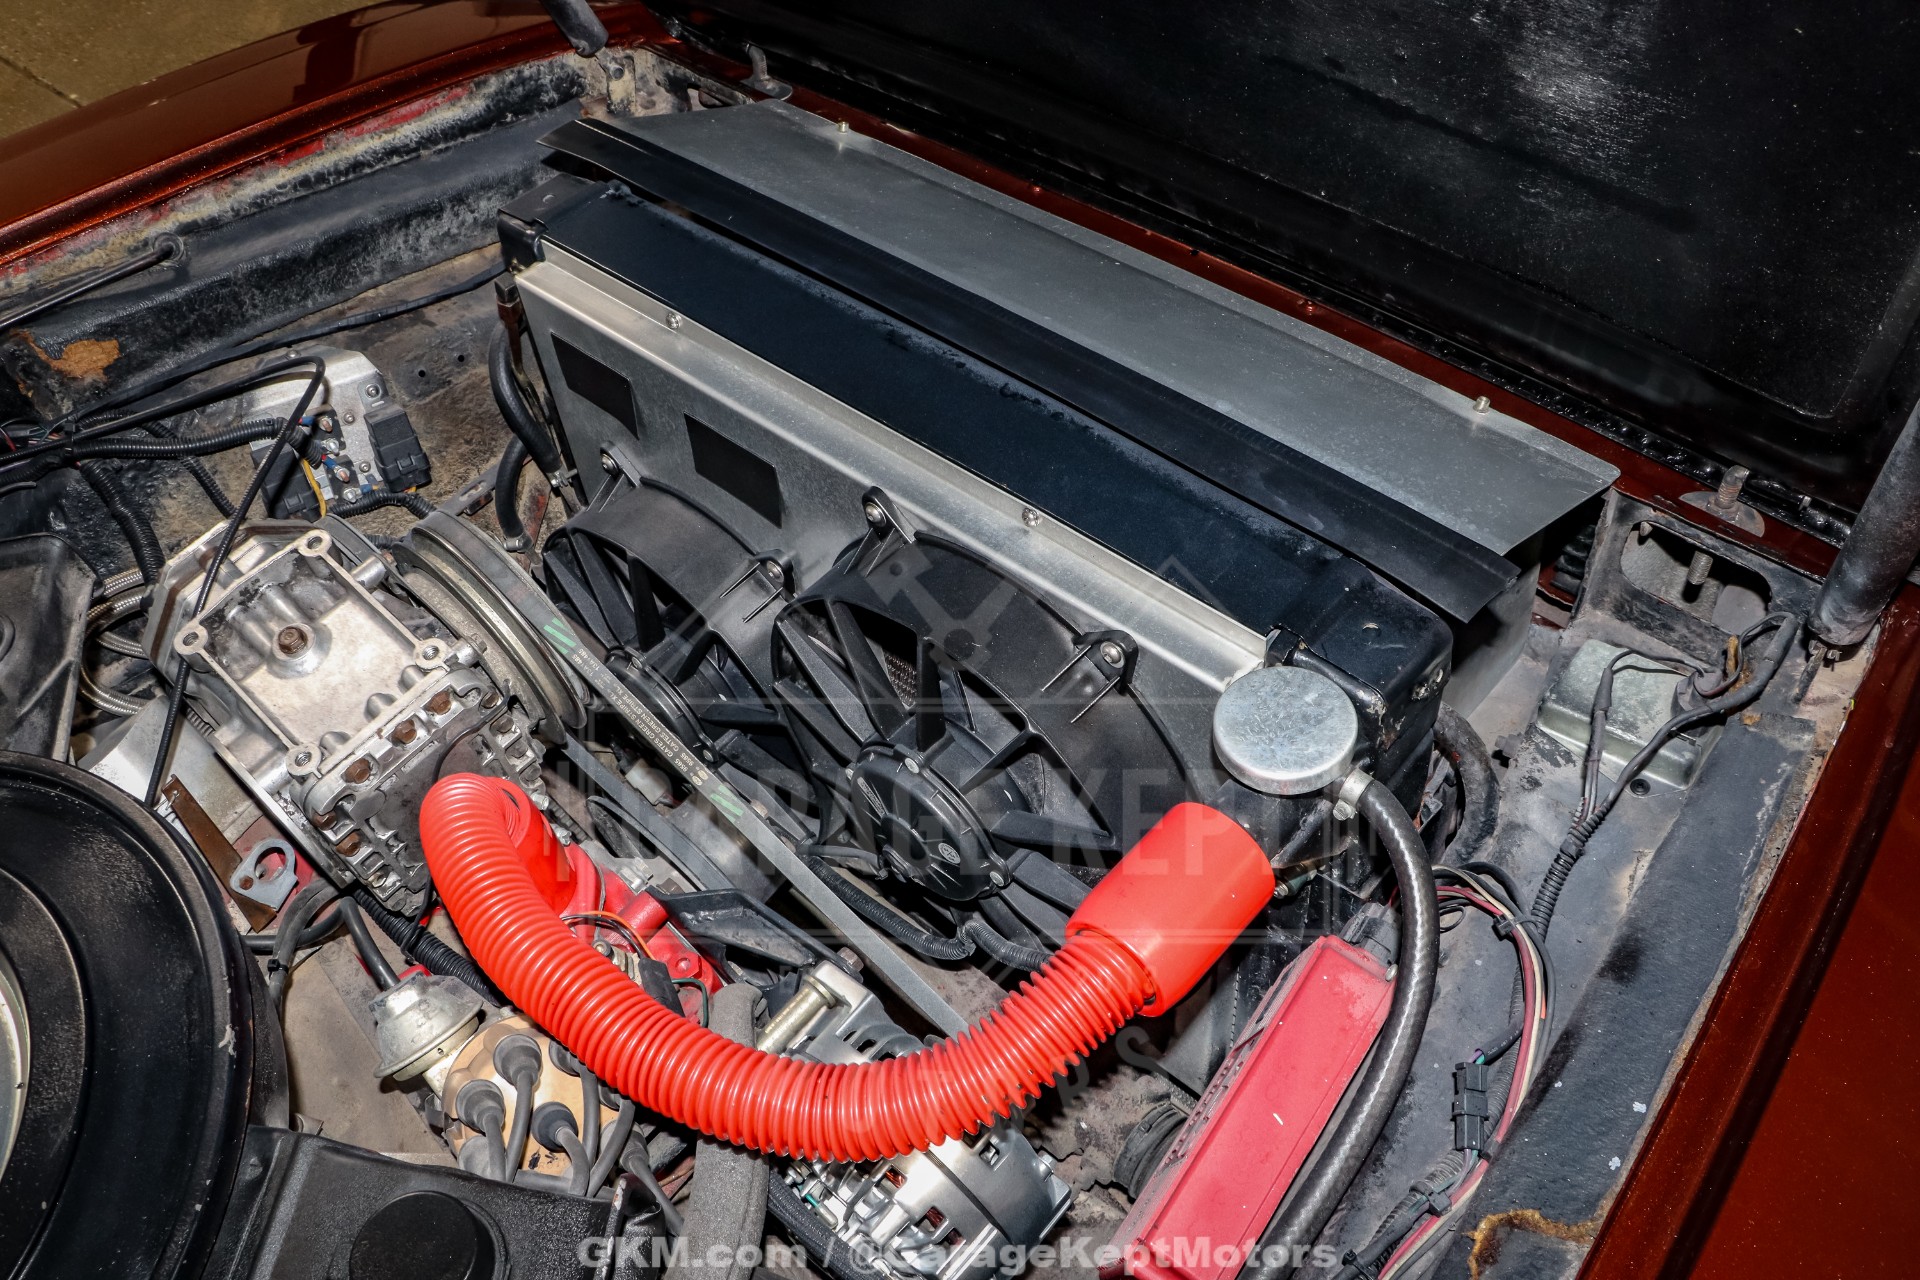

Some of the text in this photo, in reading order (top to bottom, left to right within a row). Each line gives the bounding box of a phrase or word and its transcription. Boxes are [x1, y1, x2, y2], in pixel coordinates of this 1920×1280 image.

[615, 698, 637, 720] STRIPE
[621, 693, 643, 715] STRIPE
[634, 717, 655, 739] GREEN
[640, 712, 661, 733] GREEN
[653, 736, 674, 758] GATES
[659, 731, 680, 752] GATES
